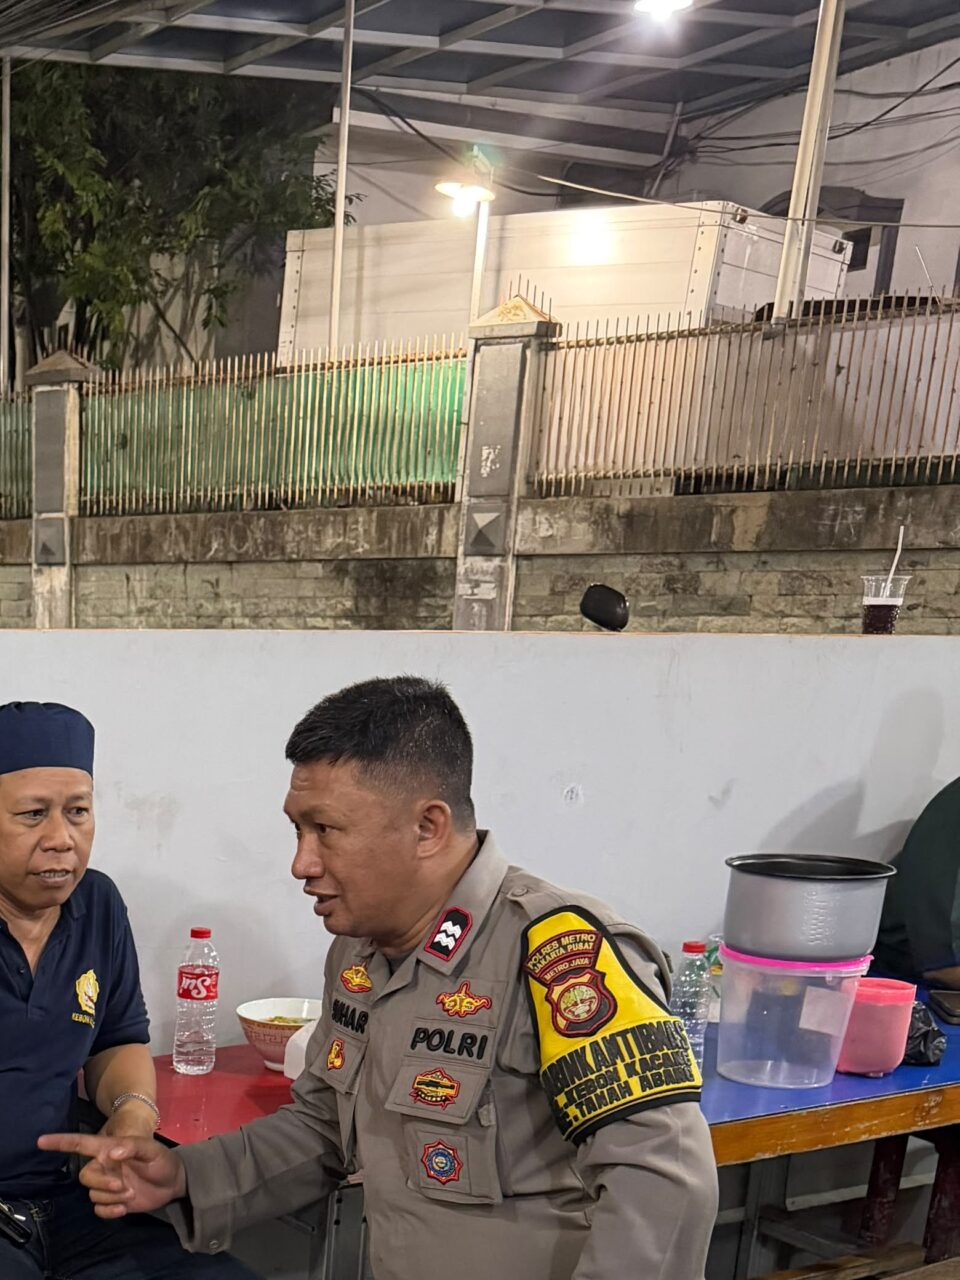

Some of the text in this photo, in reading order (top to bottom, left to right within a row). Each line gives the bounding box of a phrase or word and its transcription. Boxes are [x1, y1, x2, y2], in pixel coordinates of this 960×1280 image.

[527, 933, 596, 969] POLRES METRO
[534, 942, 594, 973] JAKARTA PUSAT
[543, 957, 589, 980] METRO JAYA
[410, 1027, 488, 1060] POLRI
